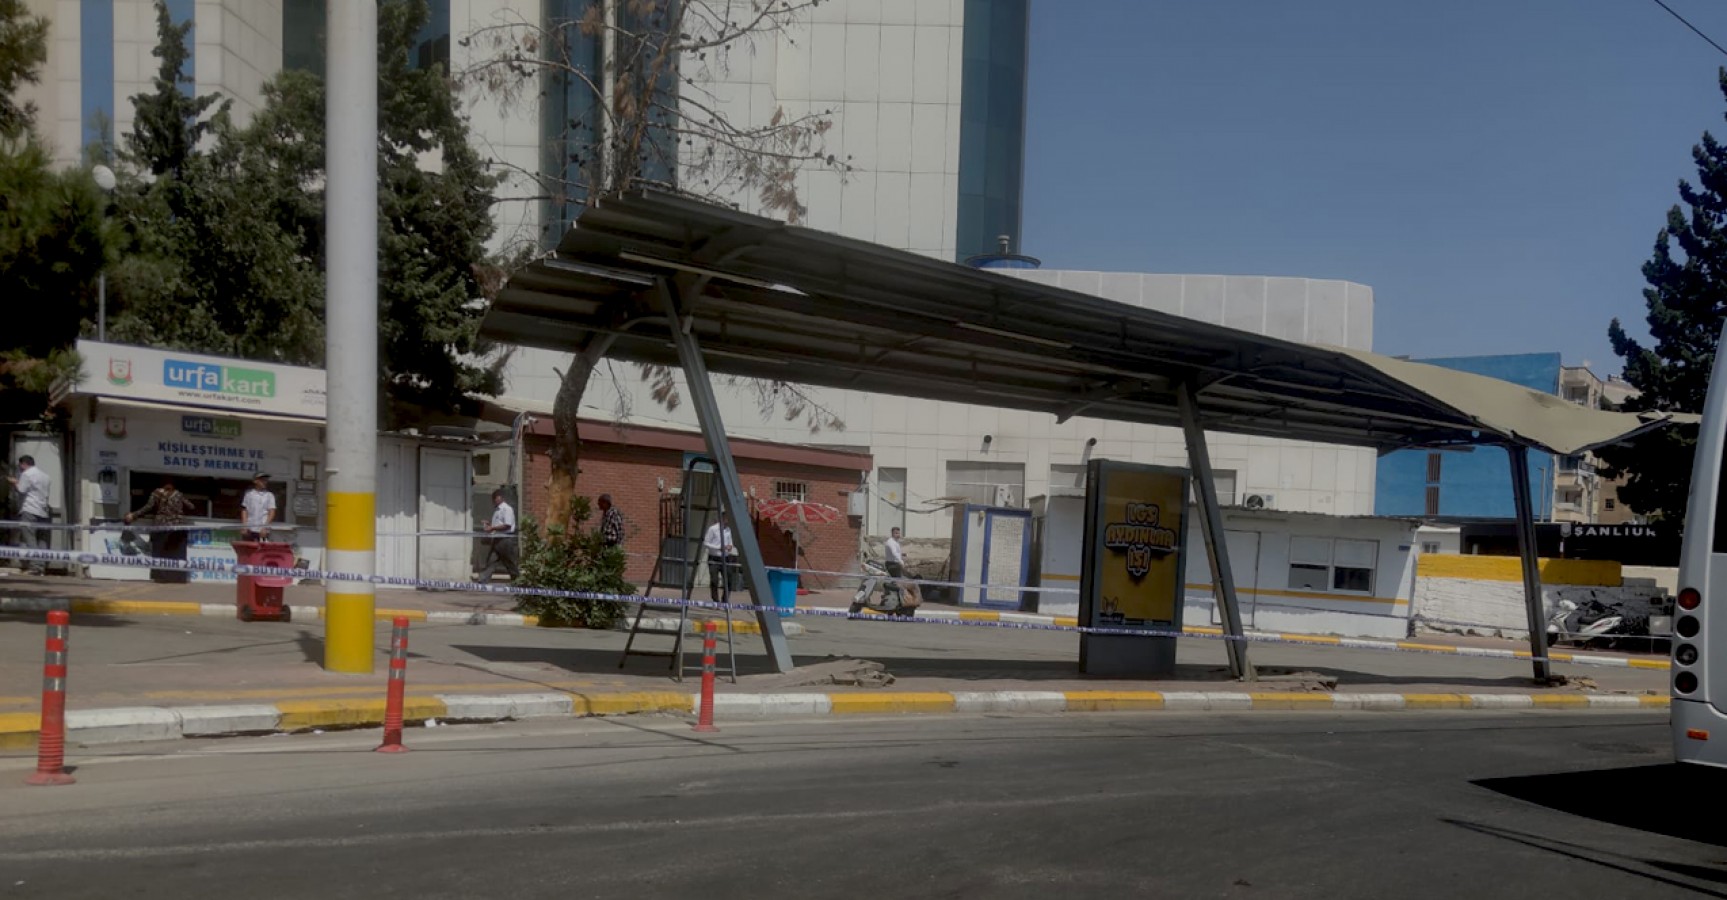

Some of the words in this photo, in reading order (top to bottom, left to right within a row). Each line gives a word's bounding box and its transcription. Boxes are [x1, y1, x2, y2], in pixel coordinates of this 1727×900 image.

[169, 365, 270, 396] urfakart
[178, 389, 261, 405] www.urfakart.com
[249, 450, 264, 459] VE
[163, 455, 199, 469] SATIŞ
[204, 458, 259, 471] MERKEZİ
